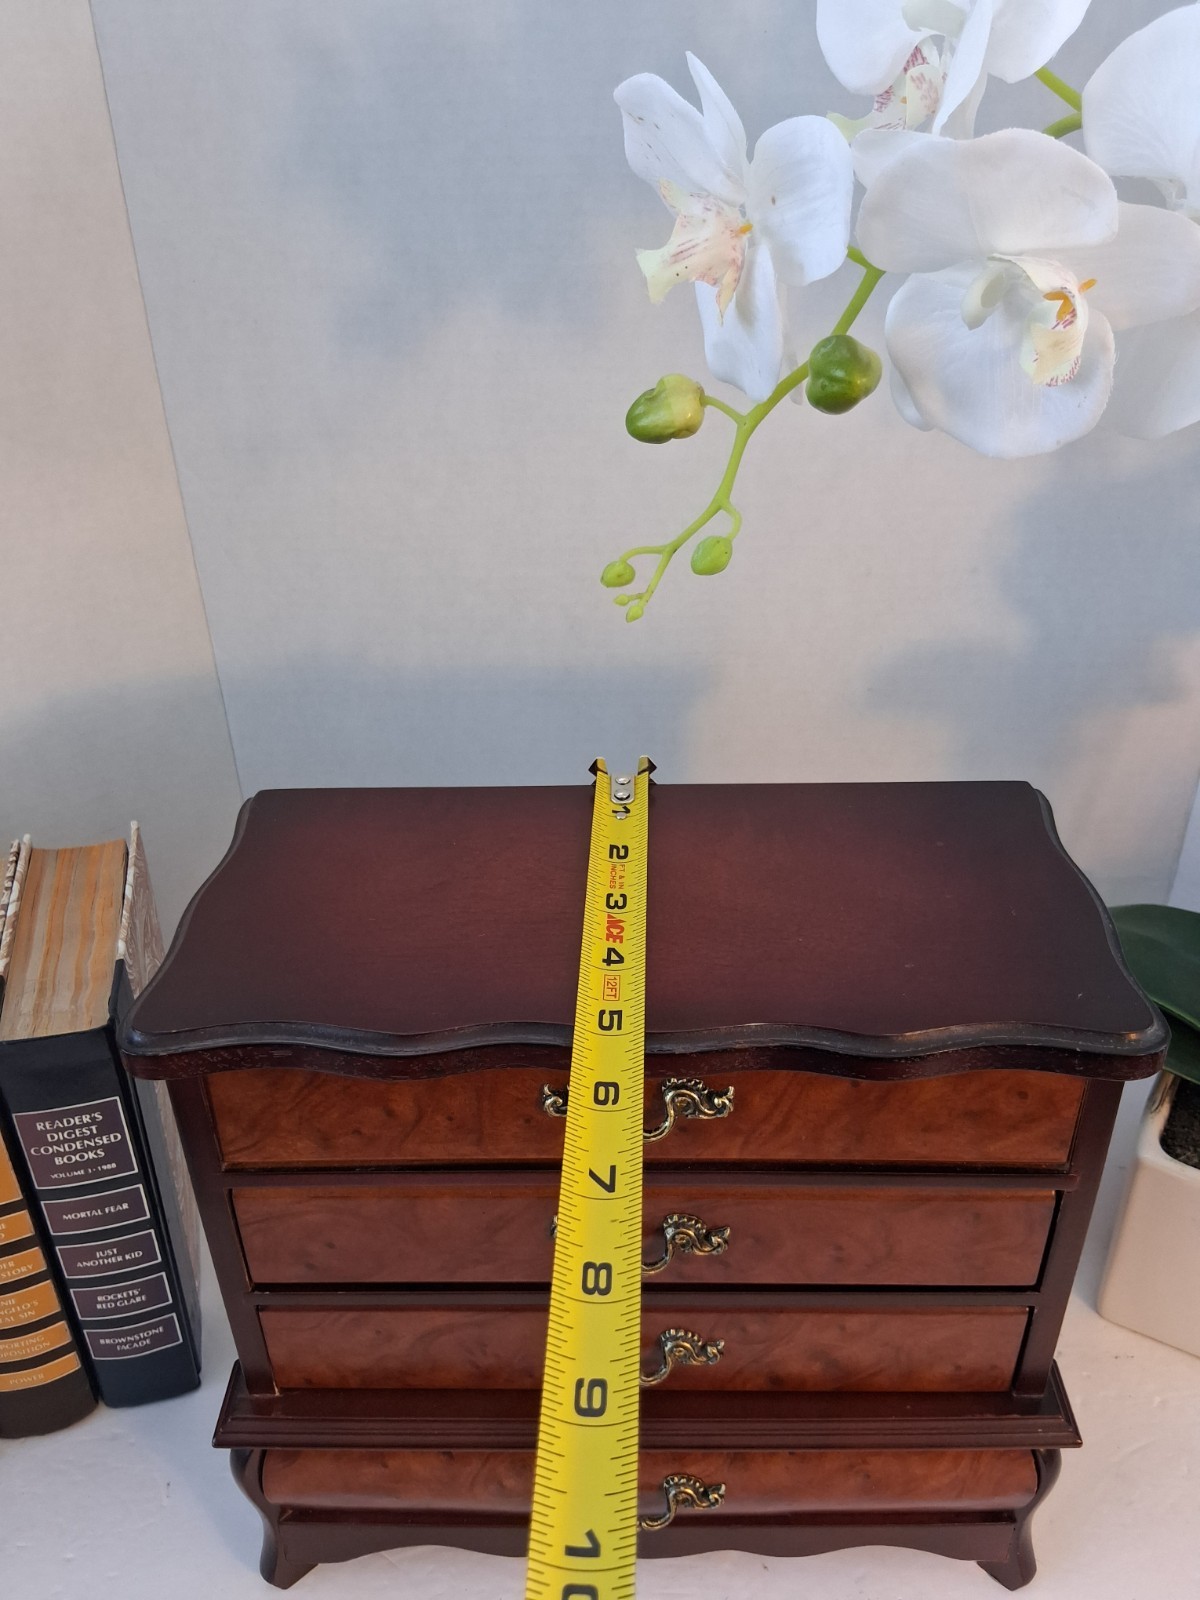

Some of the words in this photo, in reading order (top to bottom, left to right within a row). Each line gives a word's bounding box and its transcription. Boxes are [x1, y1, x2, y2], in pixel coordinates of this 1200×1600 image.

[608, 844, 629, 860] 2
[609, 864, 617, 889] INCHES
[605, 893, 627, 910] 3
[605, 913, 627, 944] ACE
[602, 947, 625, 966] 4
[605, 977, 618, 999] 12FT
[598, 1009, 623, 1031] 5
[593, 1081, 620, 1106] 6
[36, 1111, 104, 1131] READER'S
[46, 1125, 99, 1142] DIGEST
[30, 1132, 122, 1156] CONDENSED
[54, 1148, 105, 1166] BOOKS
[50, 1169, 86, 1180] VOLUME
[588, 1164, 617, 1193] 7
[62, 1209, 104, 1221] MORTAL
[105, 1202, 130, 1214] FEAR
[76, 1256, 124, 1269] ANOTHER
[125, 1250, 143, 1261] KID
[96, 1247, 118, 1258] JUST
[581, 1261, 613, 1296] 8
[96, 1300, 115, 1310] RED
[116, 1294, 147, 1307] GLARE
[99, 1326, 165, 1345] BROWNSTONE
[116, 1338, 151, 1352] FACADE
[9, 1372, 45, 1385] POWER
[573, 1377, 608, 1418] 9
